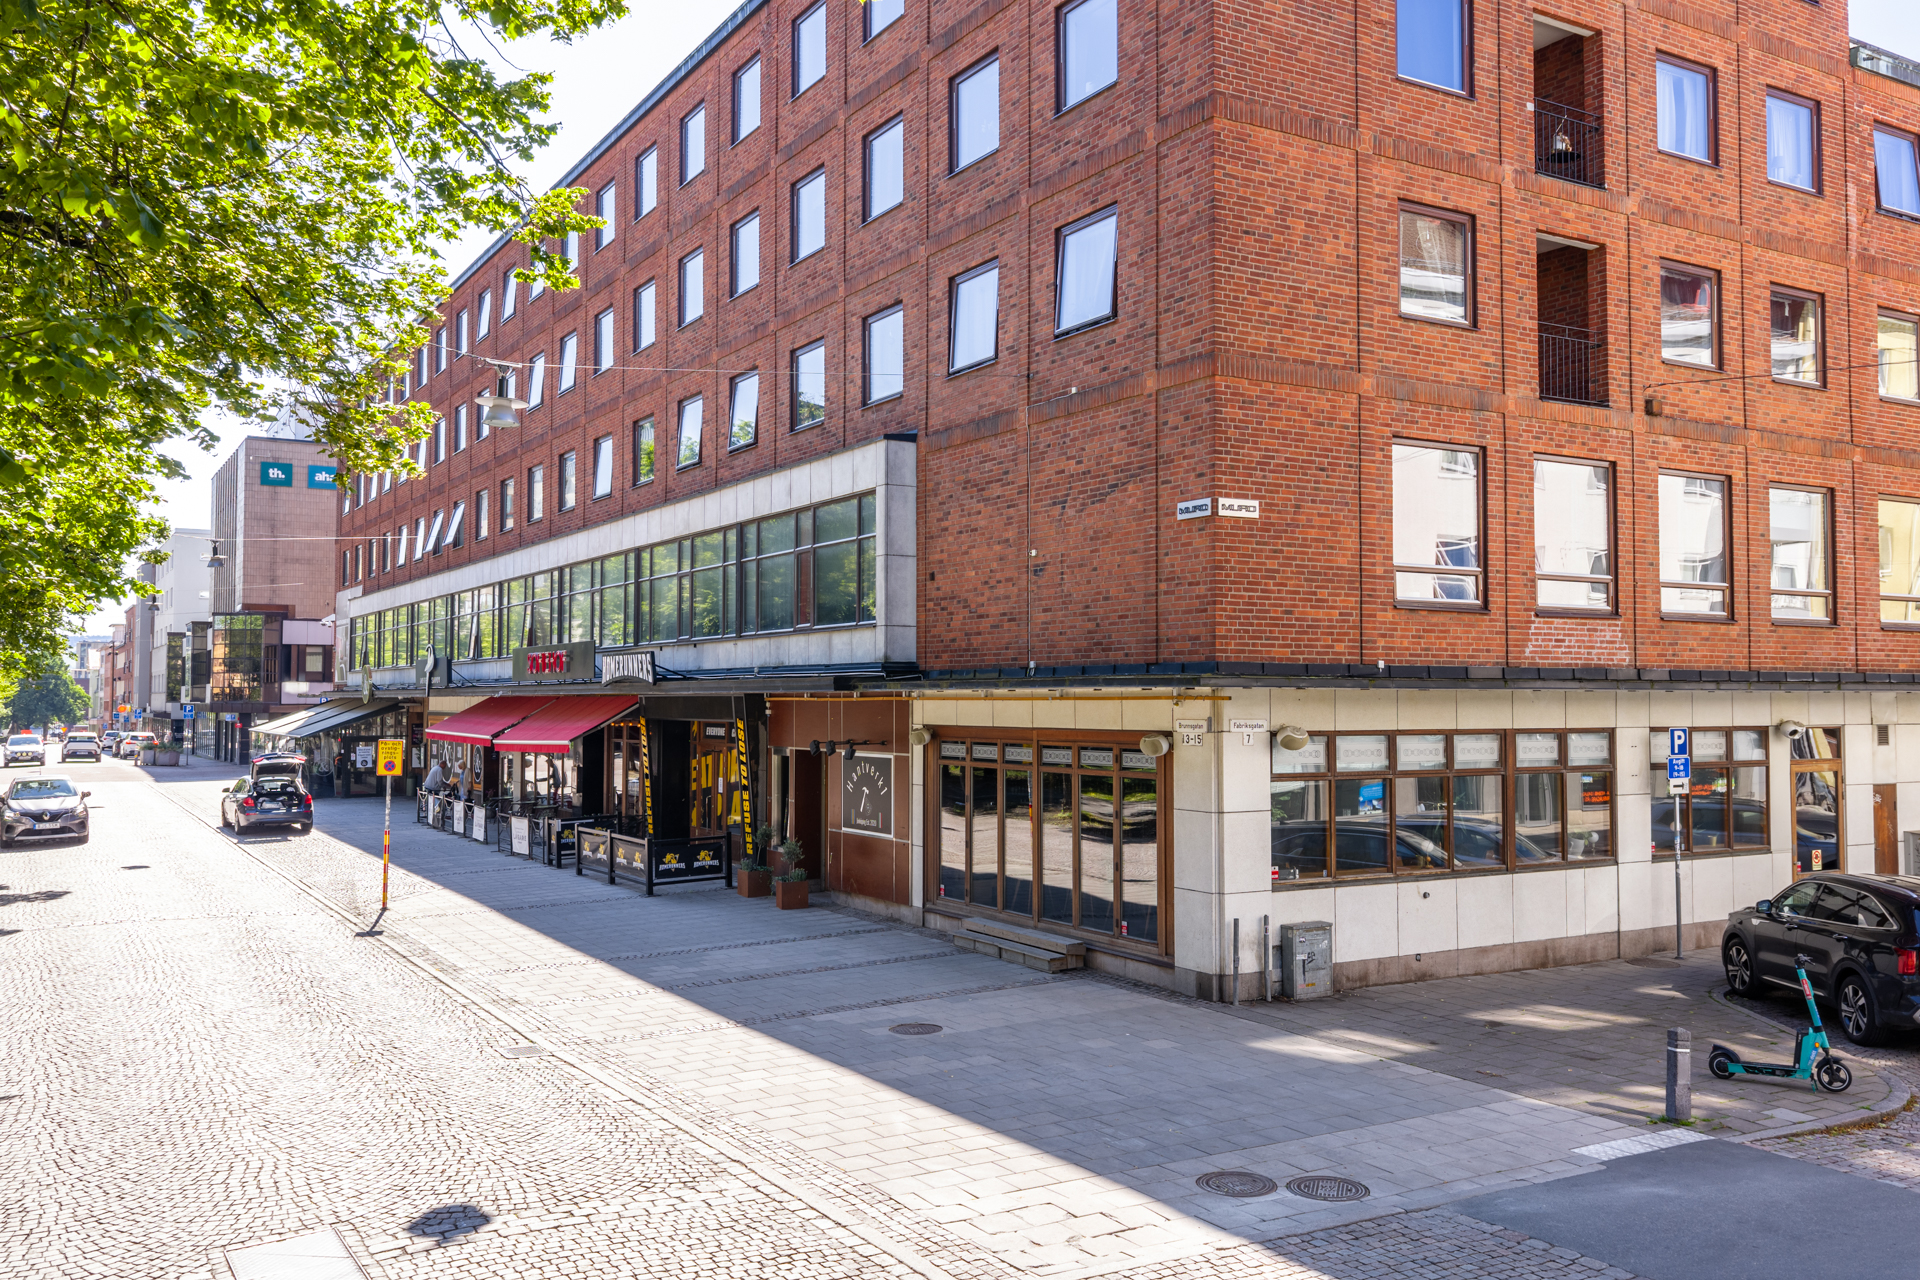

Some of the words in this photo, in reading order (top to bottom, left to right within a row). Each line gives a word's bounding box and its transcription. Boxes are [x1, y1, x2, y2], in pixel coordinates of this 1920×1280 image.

[602, 653, 652, 685] HOMERUNNERS
[706, 726, 726, 737] EVERYONE
[1178, 722, 1204, 731] Brunnsgatan
[1233, 722, 1265, 731] Fabriksgatan
[737, 717, 747, 763] LOSE
[1182, 734, 1202, 744] 13-15
[1246, 734, 1251, 744] 7
[1674, 730, 1685, 753] P
[740, 764, 749, 787] TO
[742, 790, 754, 855] REFUSE
